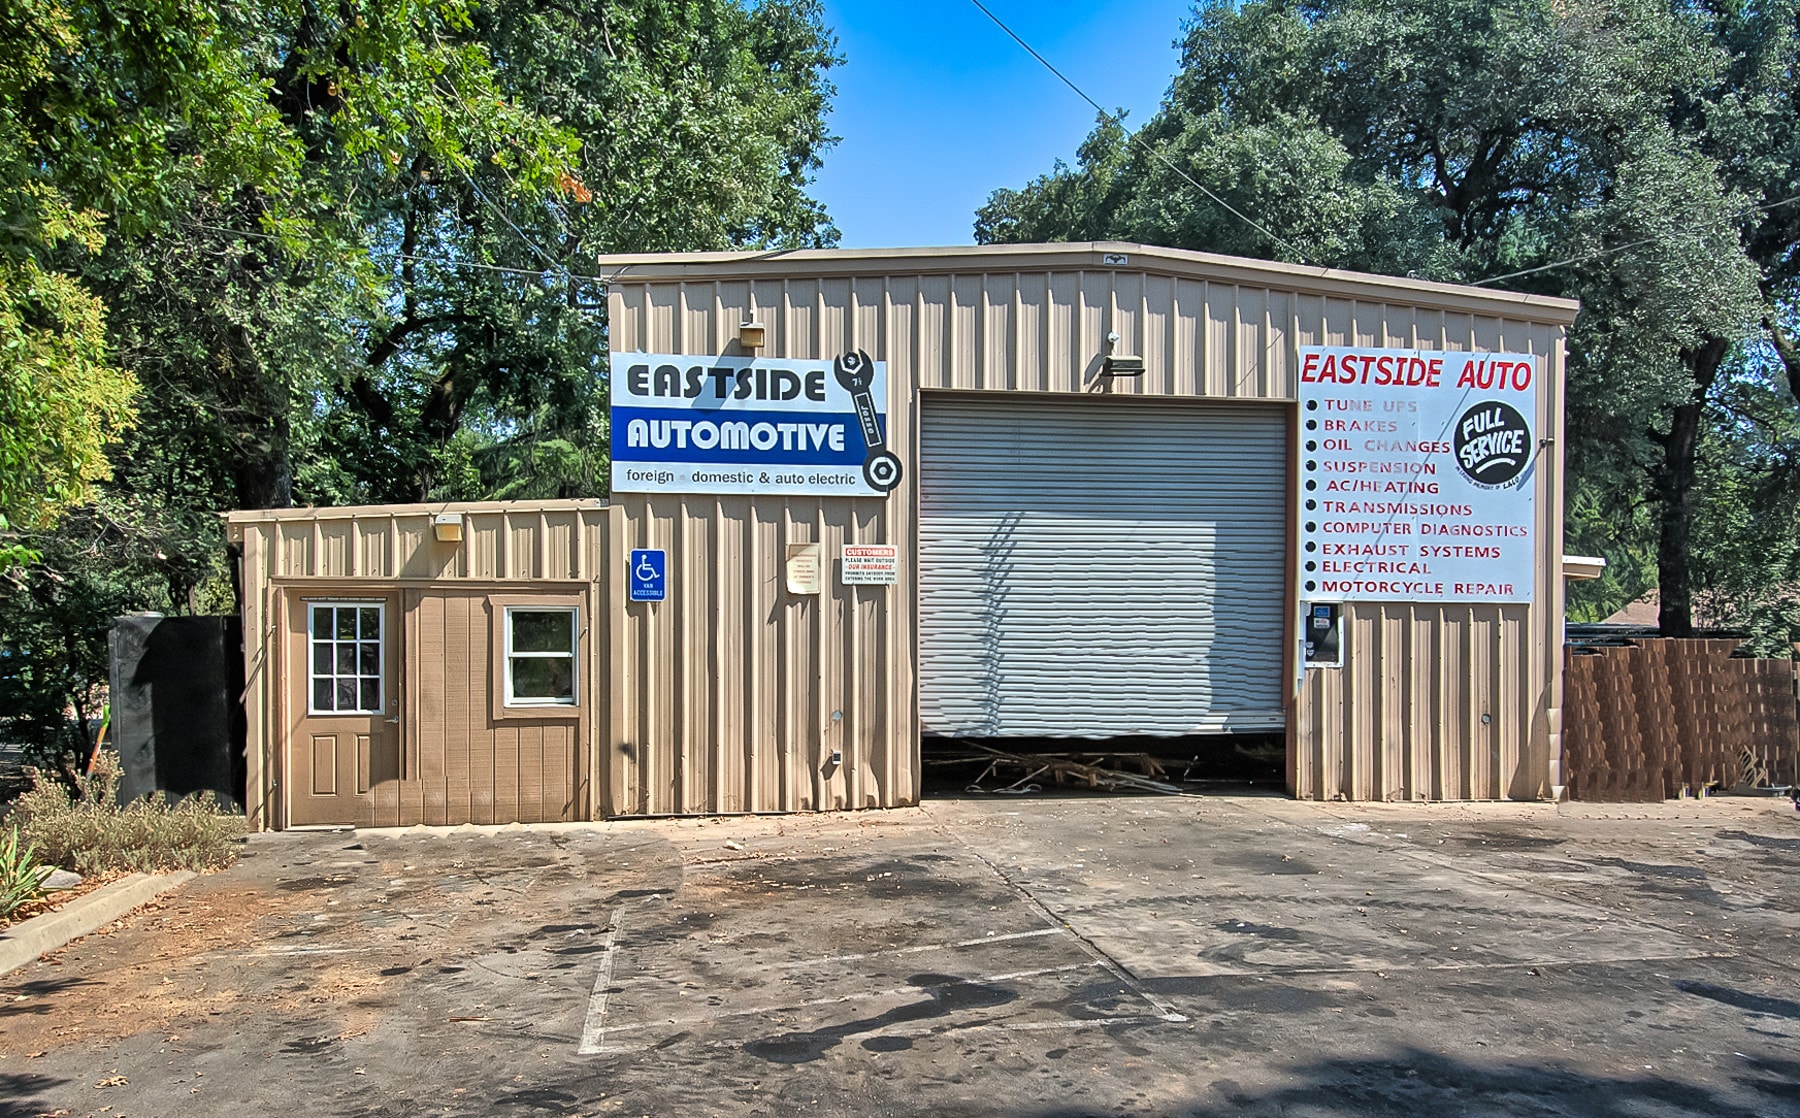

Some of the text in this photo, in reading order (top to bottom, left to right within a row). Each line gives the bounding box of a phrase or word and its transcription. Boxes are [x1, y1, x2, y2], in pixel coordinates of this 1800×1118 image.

[1301, 354, 1533, 392] EASTSIDE AUTO
[627, 365, 826, 402] EASTSIDE
[1324, 399, 1417, 413] TUNE UPS
[1324, 420, 1398, 432] BRAKES
[1462, 407, 1505, 441] FULL
[627, 419, 846, 452] AUTOMOTIVE
[1323, 439, 1451, 453] OIL CHANGES
[1459, 429, 1525, 469] SERVICE
[1323, 461, 1436, 475] SUSPENSION
[626, 468, 856, 485] foreign domestic & auto electric
[1326, 480, 1439, 494] AC/HEATING
[1323, 501, 1473, 516] TRANSMISSIONS
[1322, 522, 1528, 537] COMPUTER DIAGNOSTICS
[846, 548, 893, 556] CUSTOMERS
[1322, 544, 1501, 559] EXHAUST SYSTEMS
[1322, 561, 1432, 574] ELECTRICAL
[1322, 580, 1514, 595] MOTORCYCLE REPAIR
